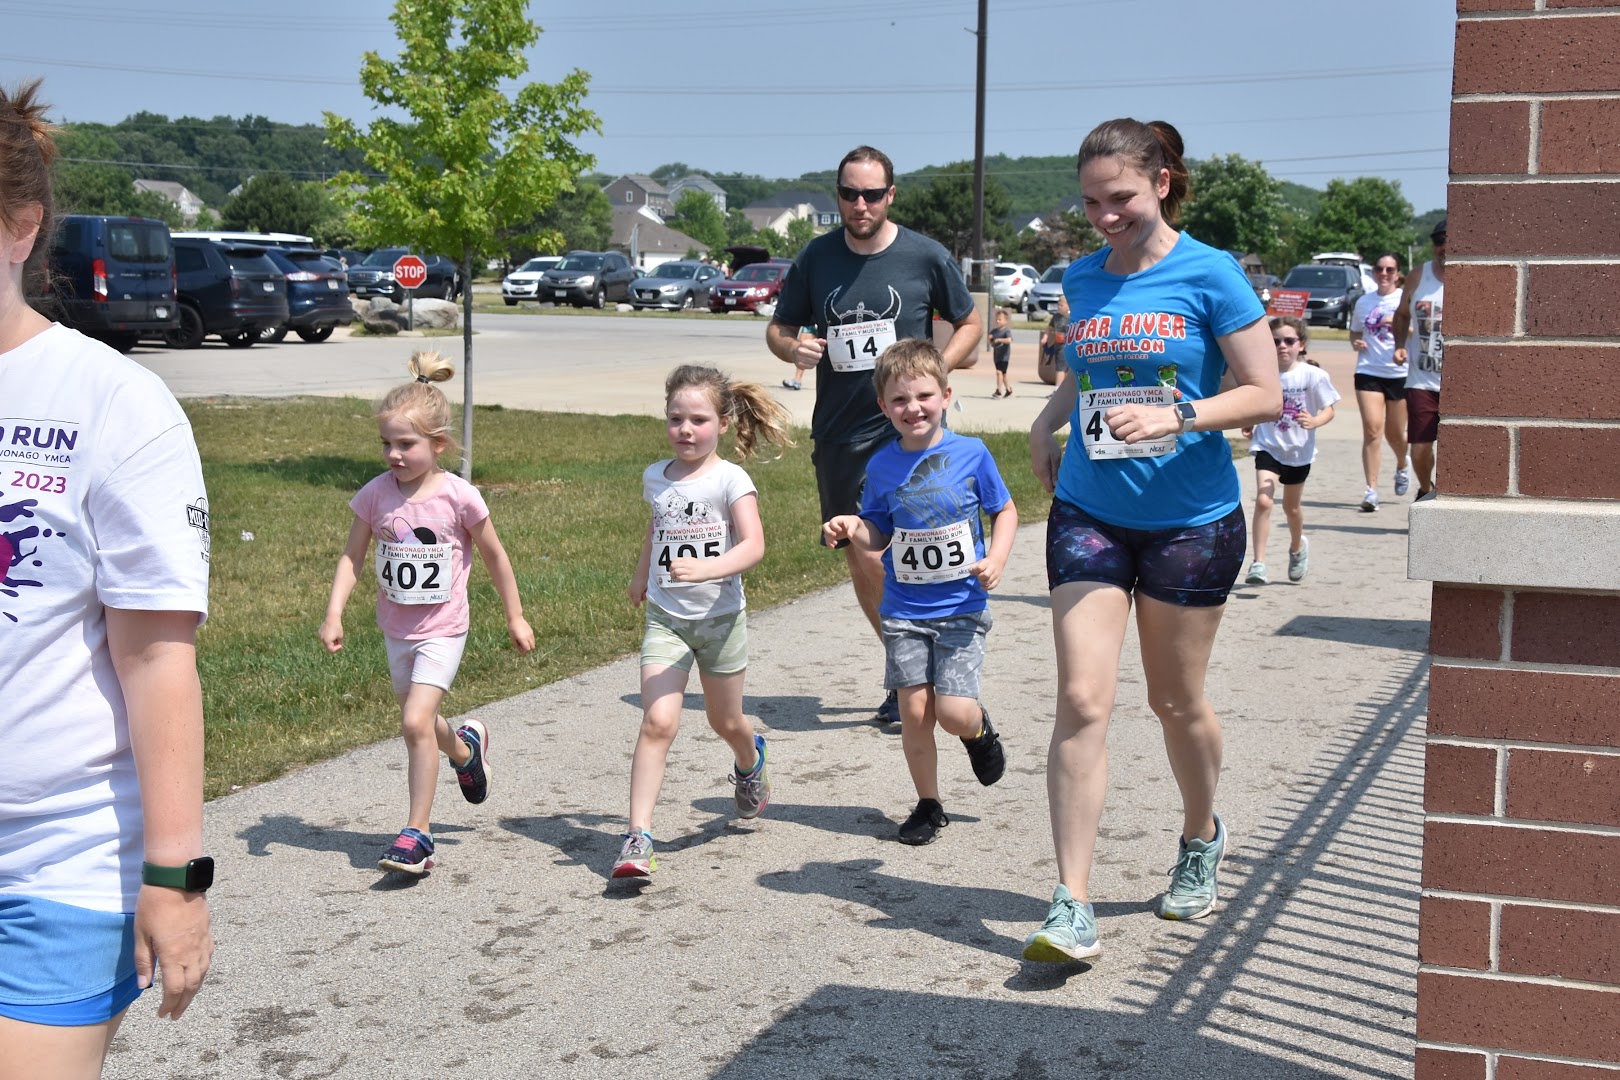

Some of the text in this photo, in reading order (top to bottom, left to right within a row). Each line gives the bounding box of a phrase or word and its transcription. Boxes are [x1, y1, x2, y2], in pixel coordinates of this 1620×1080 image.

[396, 265, 424, 279] STOP
[1065, 312, 1186, 345] UGAR RIVER
[845, 336, 878, 360] 14
[1075, 338, 1165, 358] TRIATHLON
[1097, 389, 1163, 399] MUKWONAGO YMCA
[1097, 397, 1123, 406] FAMILY
[1146, 396, 1164, 404] RUN
[11, 425, 78, 451] RUN
[44, 453, 71, 463] YMCA
[11, 470, 67, 494] 2023
[666, 527, 704, 535] MUKWONAGO
[908, 530, 947, 538] MUKWONAGO
[934, 534, 950, 542] MUD
[951, 529, 963, 538] RUN
[666, 534, 688, 542] FAMILY
[387, 545, 426, 553] MUKWONAGO
[387, 551, 410, 559] FAMILY
[901, 540, 965, 571] 403
[381, 560, 440, 590] 402
